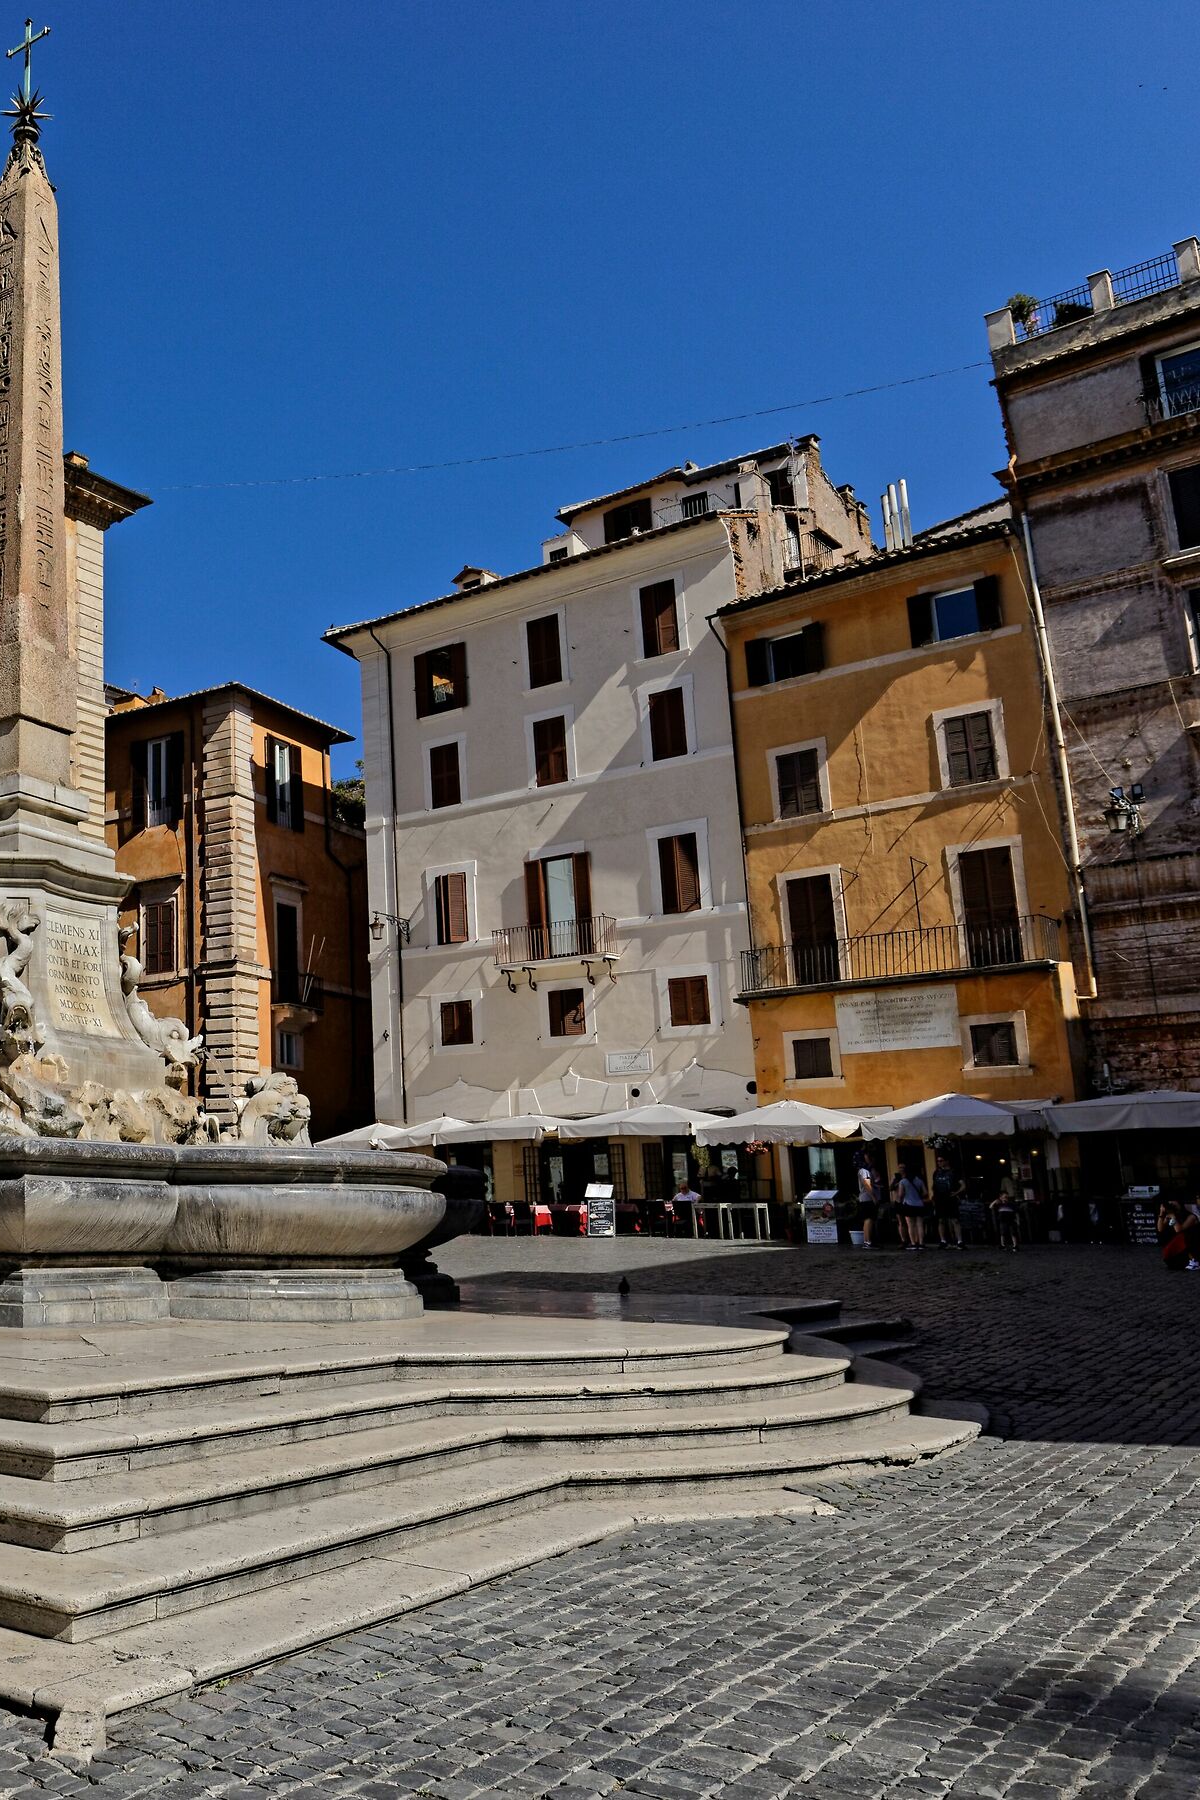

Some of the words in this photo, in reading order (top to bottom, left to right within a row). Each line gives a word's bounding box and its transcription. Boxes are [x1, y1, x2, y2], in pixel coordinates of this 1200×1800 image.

[46, 920, 85, 939] CLEMENS
[88, 929, 100, 941] XI
[71, 959, 81, 969] ET
[82, 961, 102, 972] FORI
[48, 969, 100, 986] ORNAMENTO
[55, 984, 78, 996] ANNO
